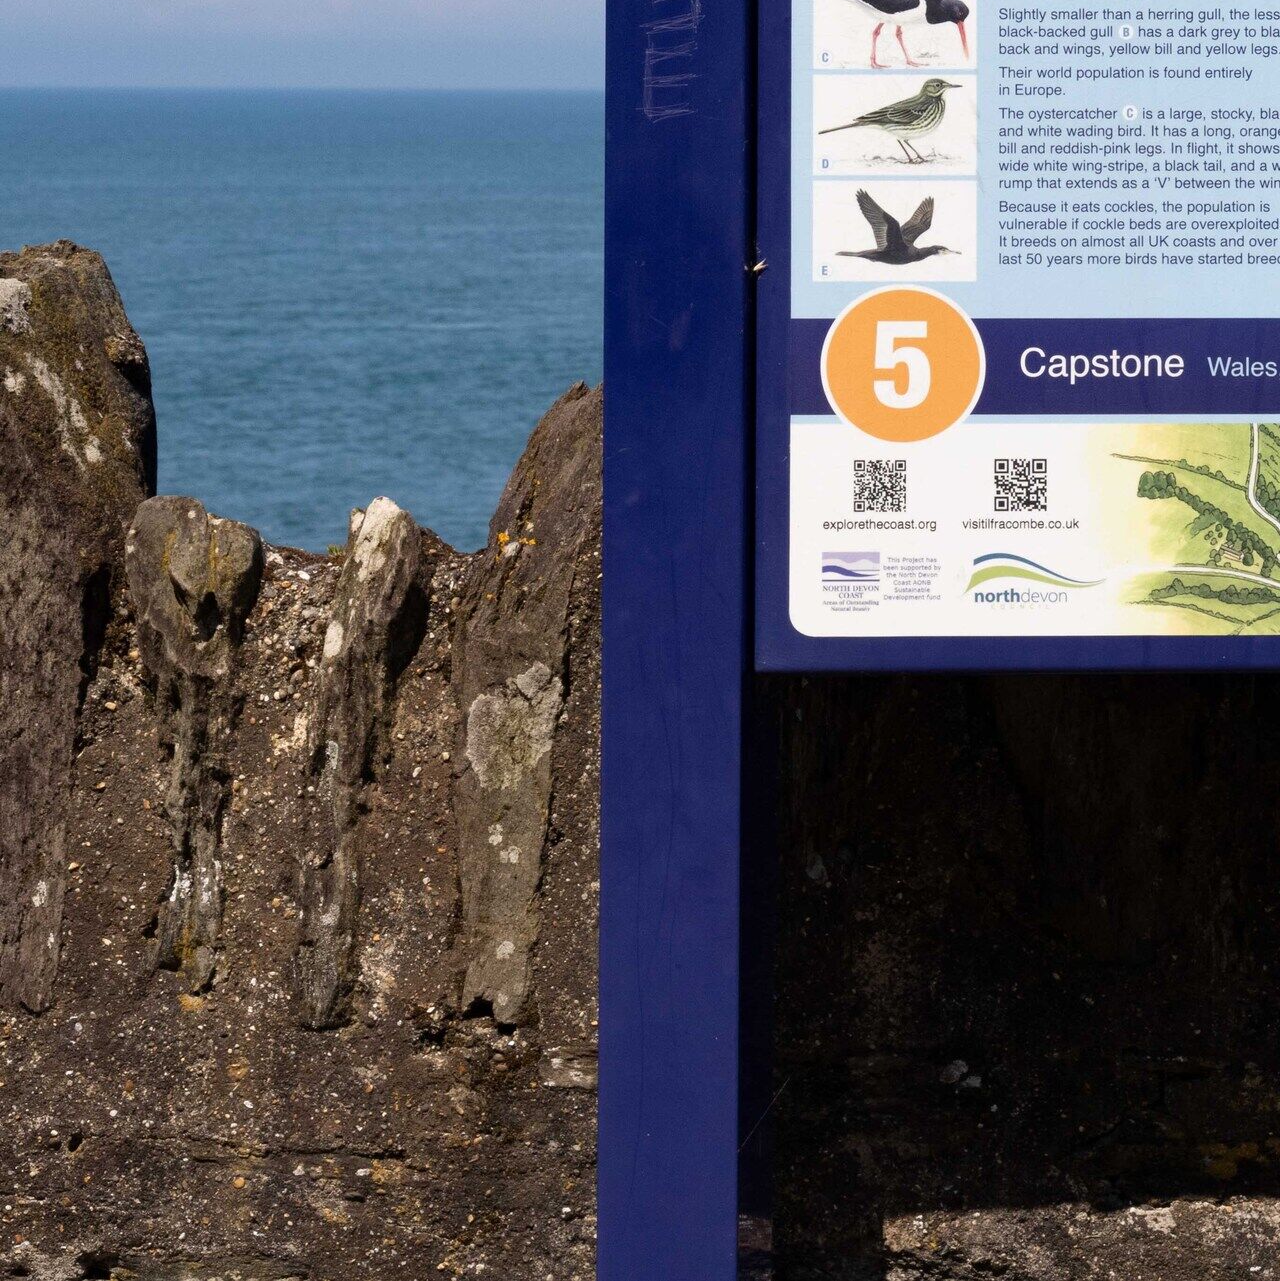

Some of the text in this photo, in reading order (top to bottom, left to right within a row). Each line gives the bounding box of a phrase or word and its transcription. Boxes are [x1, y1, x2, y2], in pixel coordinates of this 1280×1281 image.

[821, 52, 829, 63] C
[821, 159, 829, 170] D
[821, 265, 828, 276] E
[874, 320, 931, 410] 5
[1020, 346, 1185, 385] Capstone
[822, 518, 937, 532] explorethecoast.org
[962, 518, 1080, 530] visitilfracombe.co.uk
[974, 588, 1068, 603] northdevon
